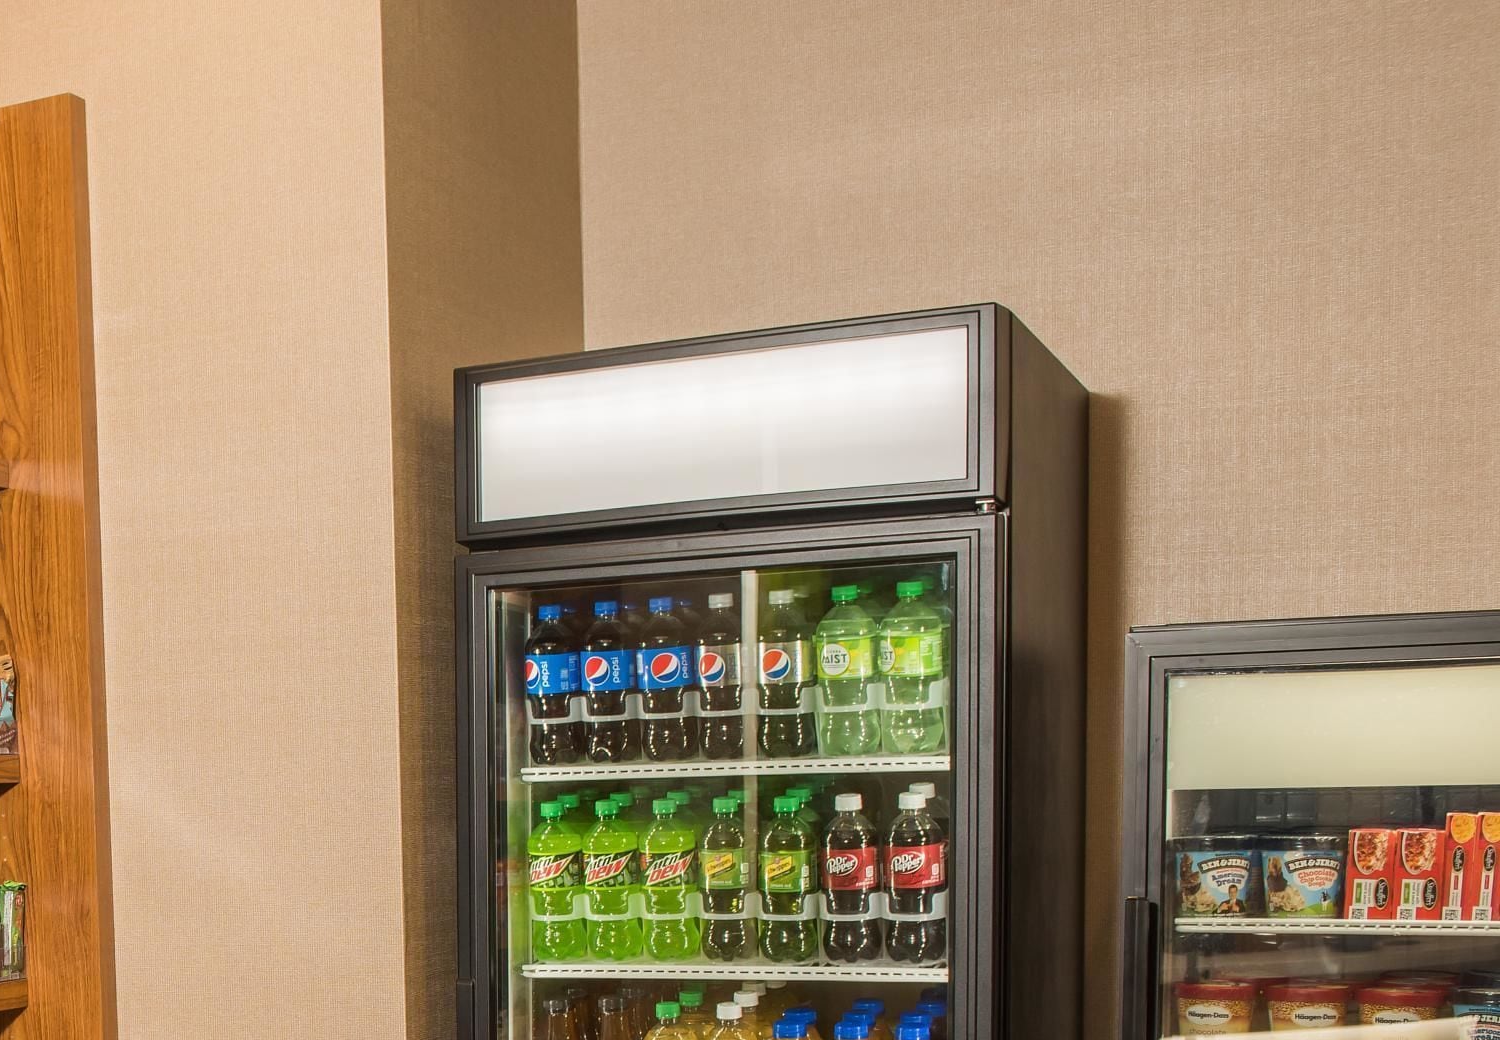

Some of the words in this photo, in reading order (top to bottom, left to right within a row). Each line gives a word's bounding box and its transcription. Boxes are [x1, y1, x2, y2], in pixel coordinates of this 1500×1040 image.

[822, 653, 848, 665] MIST
[540, 661, 549, 688] pepsi
[611, 656, 621, 684] pepsi
[836, 856, 847, 864] Dr
[904, 853, 914, 862] Dr
[828, 858, 855, 874] Pepper
[893, 856, 921, 872] Pepper
[1212, 871, 1246, 882] American
[1297, 868, 1336, 879] Chocolate
[1216, 878, 1243, 888] Dream
[1188, 1010, 1229, 1020] Häagen-Dazs
[1294, 1012, 1337, 1022] Häagen-Dazs
